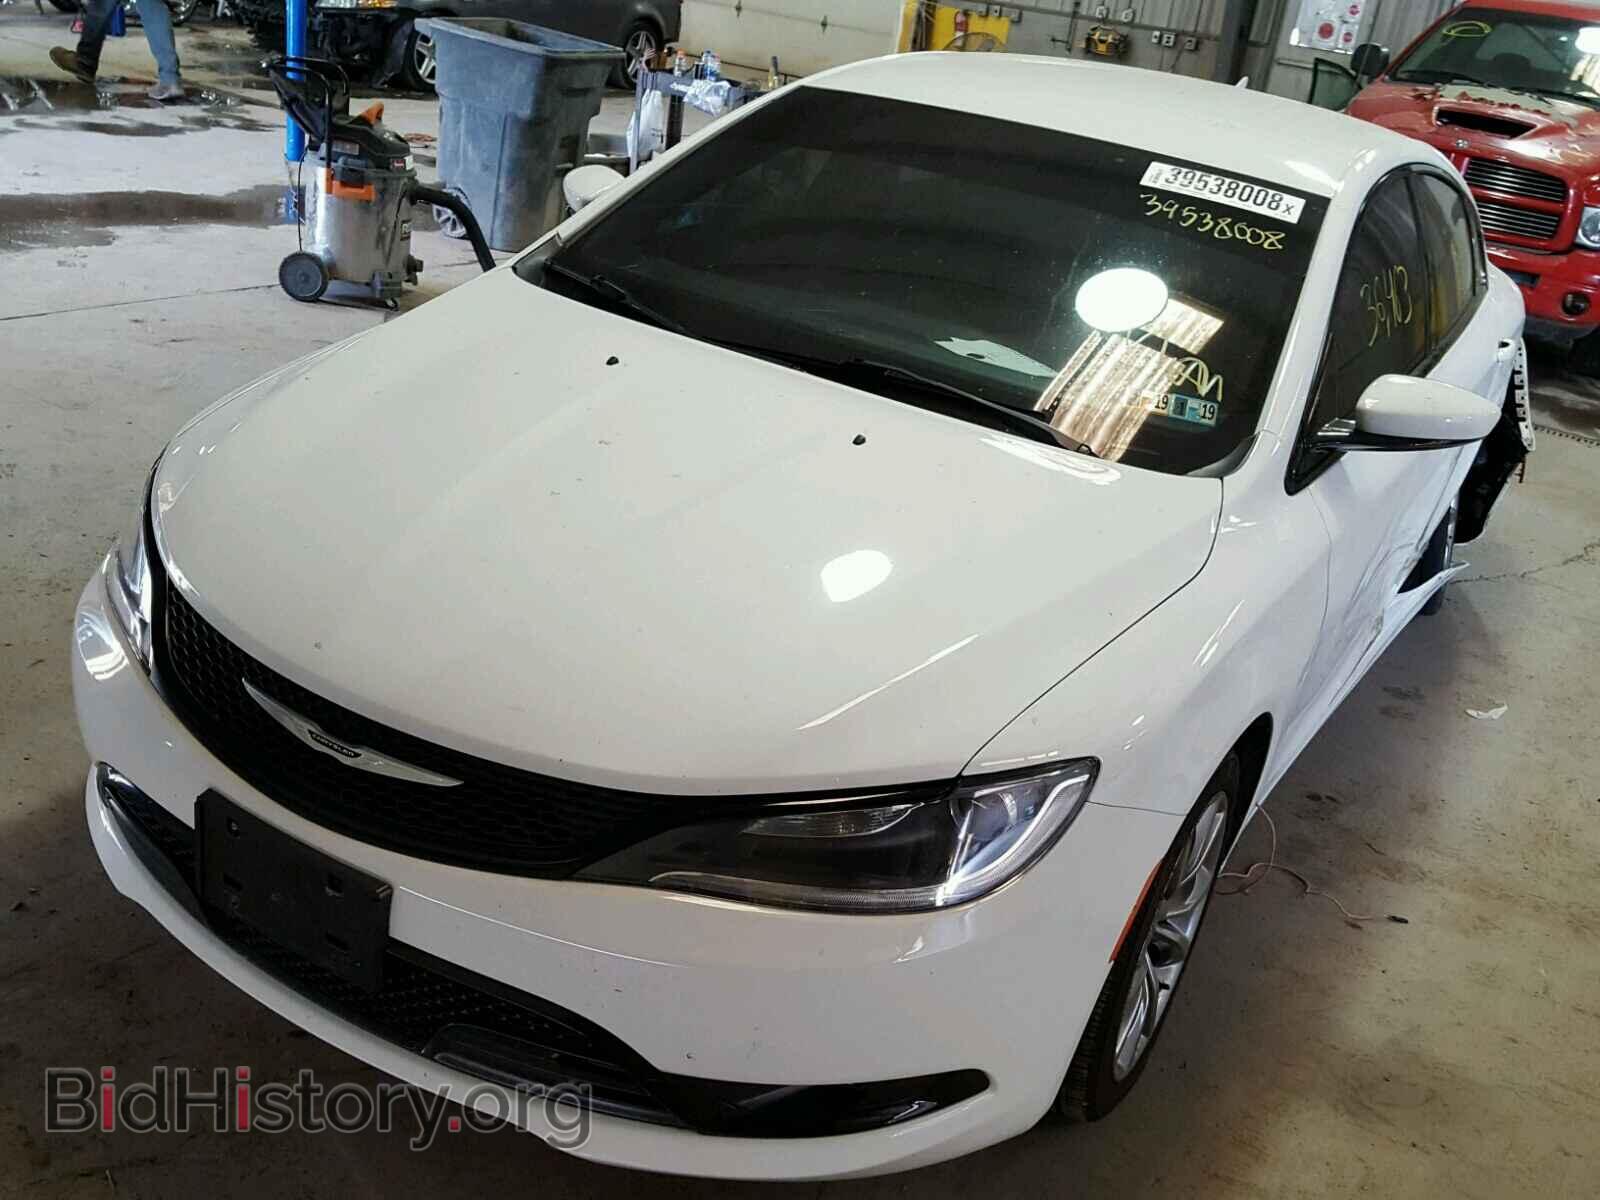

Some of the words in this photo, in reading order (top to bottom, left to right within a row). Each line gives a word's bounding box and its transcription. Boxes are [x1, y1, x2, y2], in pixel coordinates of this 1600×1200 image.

[1164, 167, 1284, 211] 39538008
[1140, 193, 1286, 250] 39538008
[1154, 394, 1169, 410] 19
[1201, 403, 1216, 420] 19
